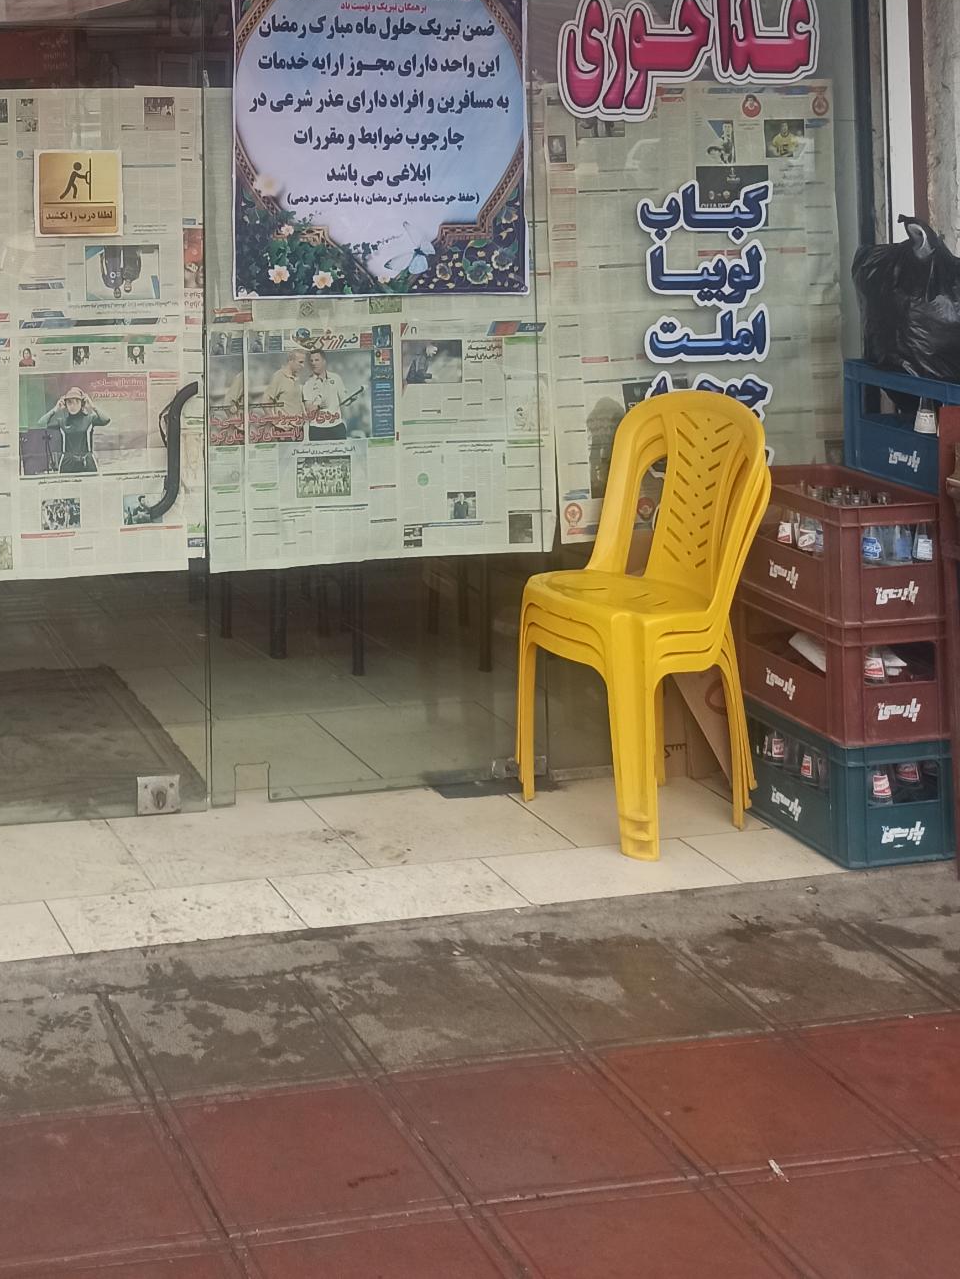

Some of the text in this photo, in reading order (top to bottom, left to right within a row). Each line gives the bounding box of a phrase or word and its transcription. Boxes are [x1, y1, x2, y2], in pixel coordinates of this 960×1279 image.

[259, 14, 495, 41] ضمن تبریک حلول ماه مبارک رمضان
[258, 51, 309, 70] خدمات
[312, 52, 344, 76] ارایه
[398, 54, 438, 77] دارای
[440, 54, 475, 77] واحد
[477, 54, 500, 77] این
[249, 88, 510, 113] به مسافرین و افراد دارای عذر شرعی در
[294, 126, 465, 151] چارچوب ضوابط و مقررات
[327, 163, 431, 187] ابلاغی می باشد
[320, 193, 352, 204] مشارکت
[366, 193, 391, 204] رمضان
[393, 193, 417, 204] مبارک
[419, 193, 431, 202] ماه
[431, 194, 456, 204] حرمت
[69, 209, 77, 222] را
[79, 210, 96, 222] درب
[97, 209, 113, 220] لطفا
[639, 183, 769, 240] کباب
[650, 244, 762, 304] لوبیا
[649, 309, 766, 358] املت
